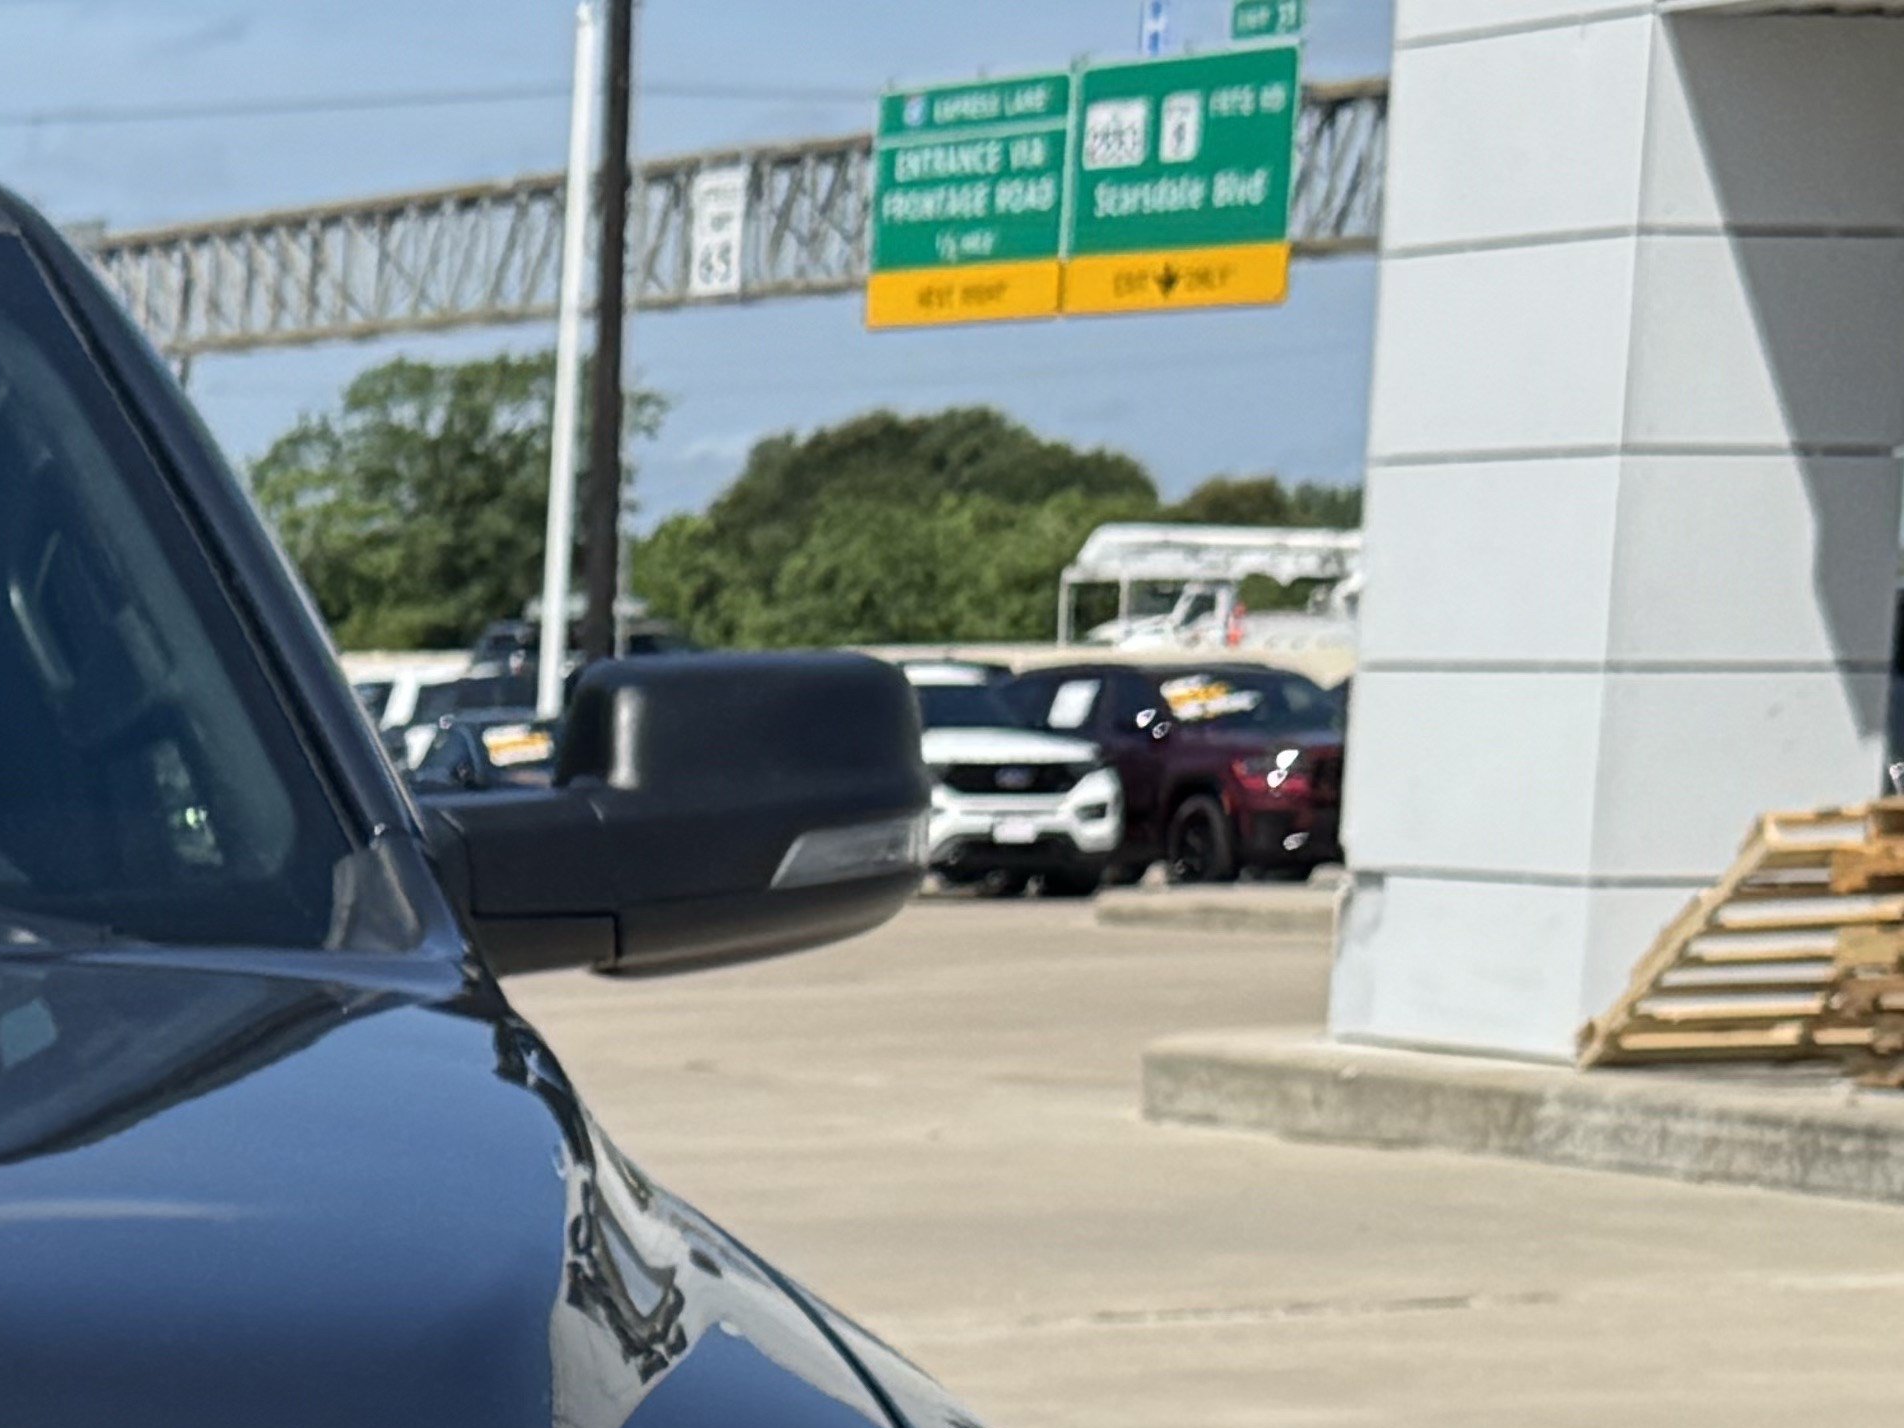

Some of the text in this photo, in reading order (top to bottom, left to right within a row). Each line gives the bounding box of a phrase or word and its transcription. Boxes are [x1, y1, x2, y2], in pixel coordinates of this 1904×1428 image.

[894, 138, 1003, 184] ENTRANCE
[881, 173, 1056, 225] FRONTAGE ROAD
[1093, 167, 1270, 219] Scarsdale Blvd
